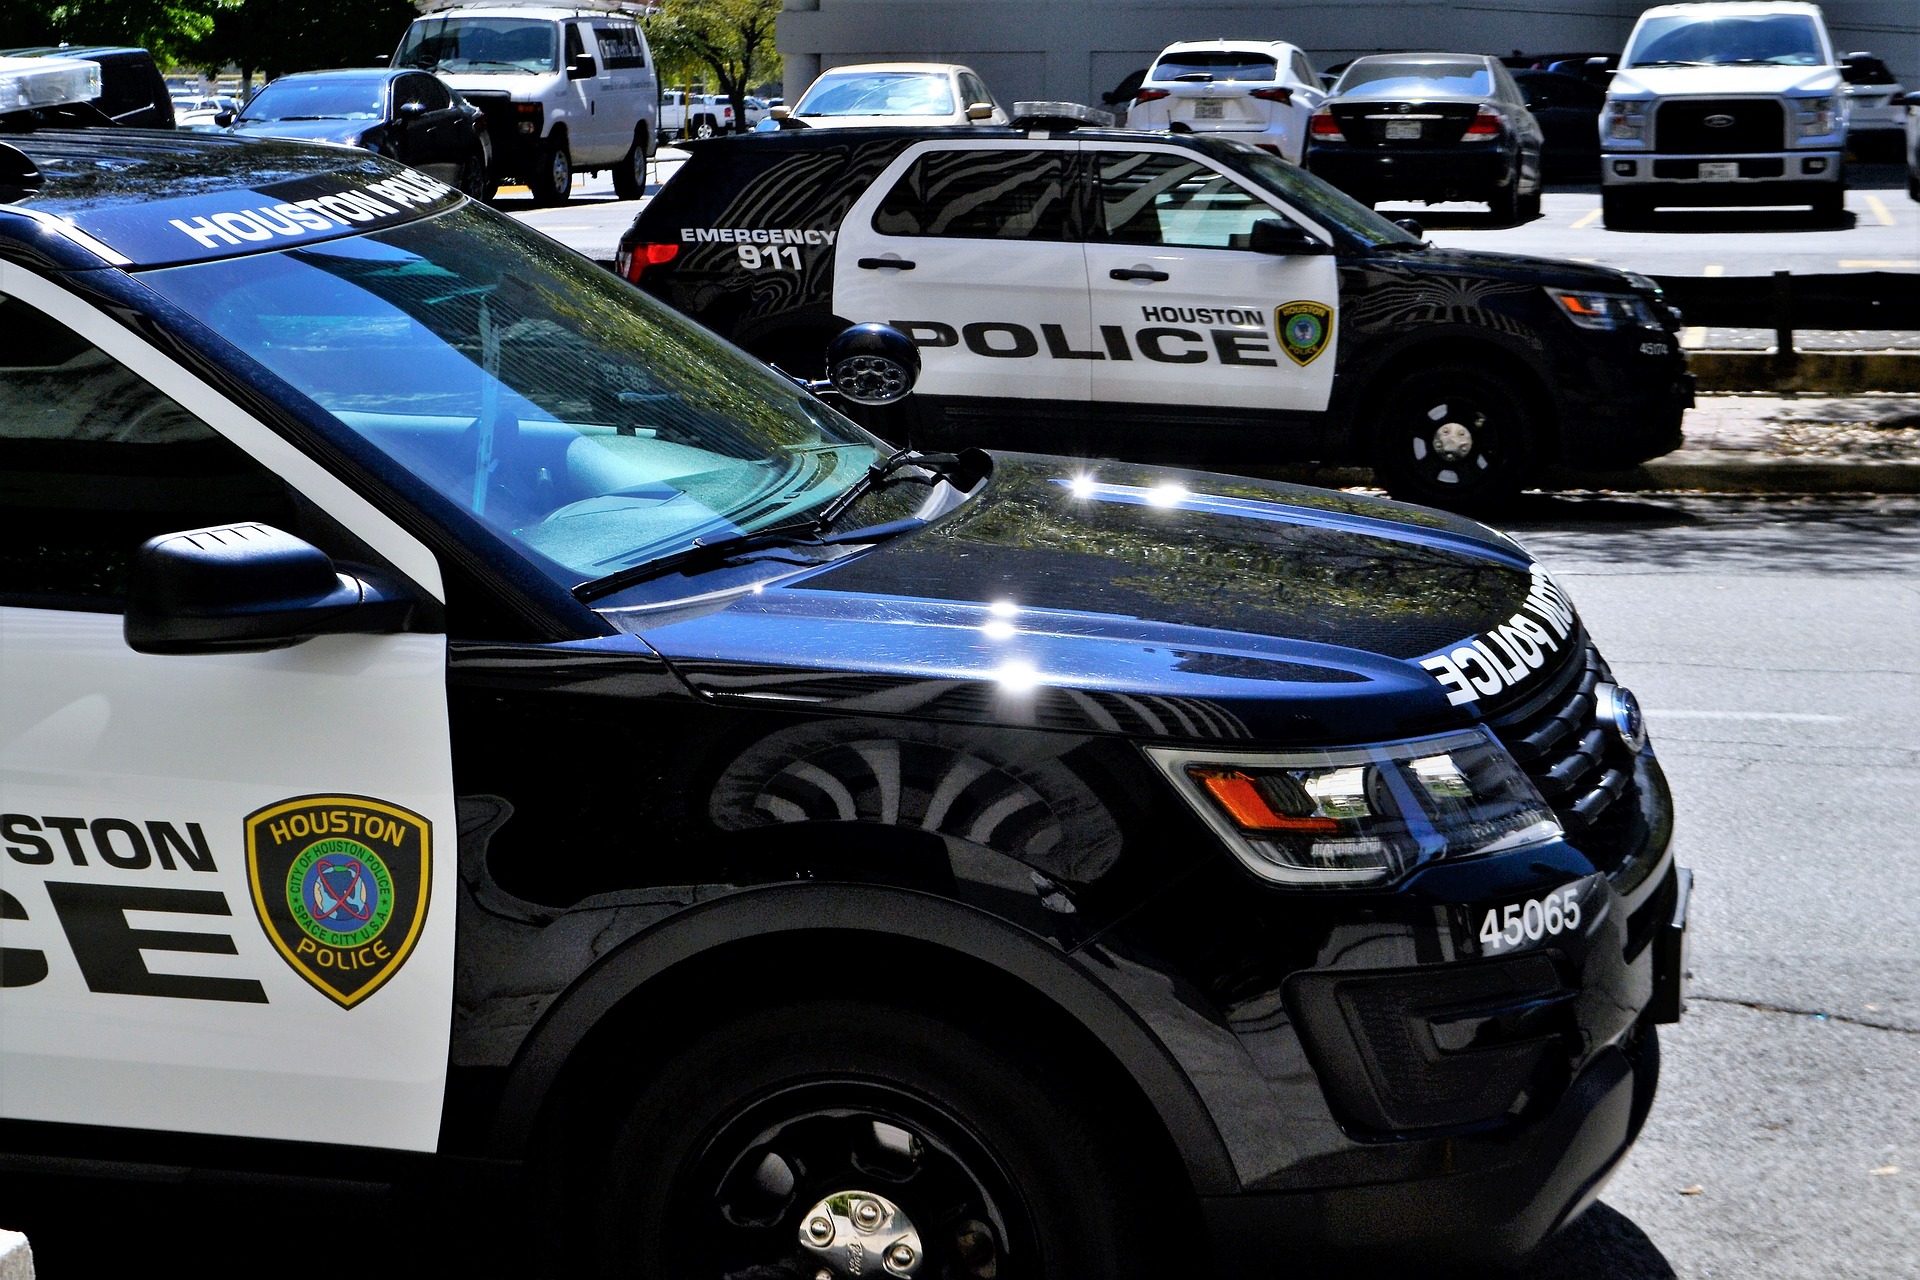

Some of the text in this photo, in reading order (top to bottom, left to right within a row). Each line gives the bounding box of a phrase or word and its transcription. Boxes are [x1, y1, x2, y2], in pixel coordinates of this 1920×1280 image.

[169, 190, 400, 249] HOUSTON
[681, 228, 837, 246] EMERGENCY
[738, 245, 802, 271] 911
[1141, 305, 1266, 327] HOUSTON
[1281, 305, 1327, 318] HOUSTON
[889, 320, 1278, 367] POLICE
[1287, 344, 1319, 356] POLICE
[1419, 613, 1560, 707] POLICE
[0, 813, 218, 873] STON
[269, 810, 406, 848] HOUSTON
[290, 840, 391, 896] CITY OF HOUSTON POLICE
[294, 905, 390, 946] SPACE CITY U.S.A.
[1479, 887, 1581, 949] 45065
[296, 936, 392, 970] POLICE
